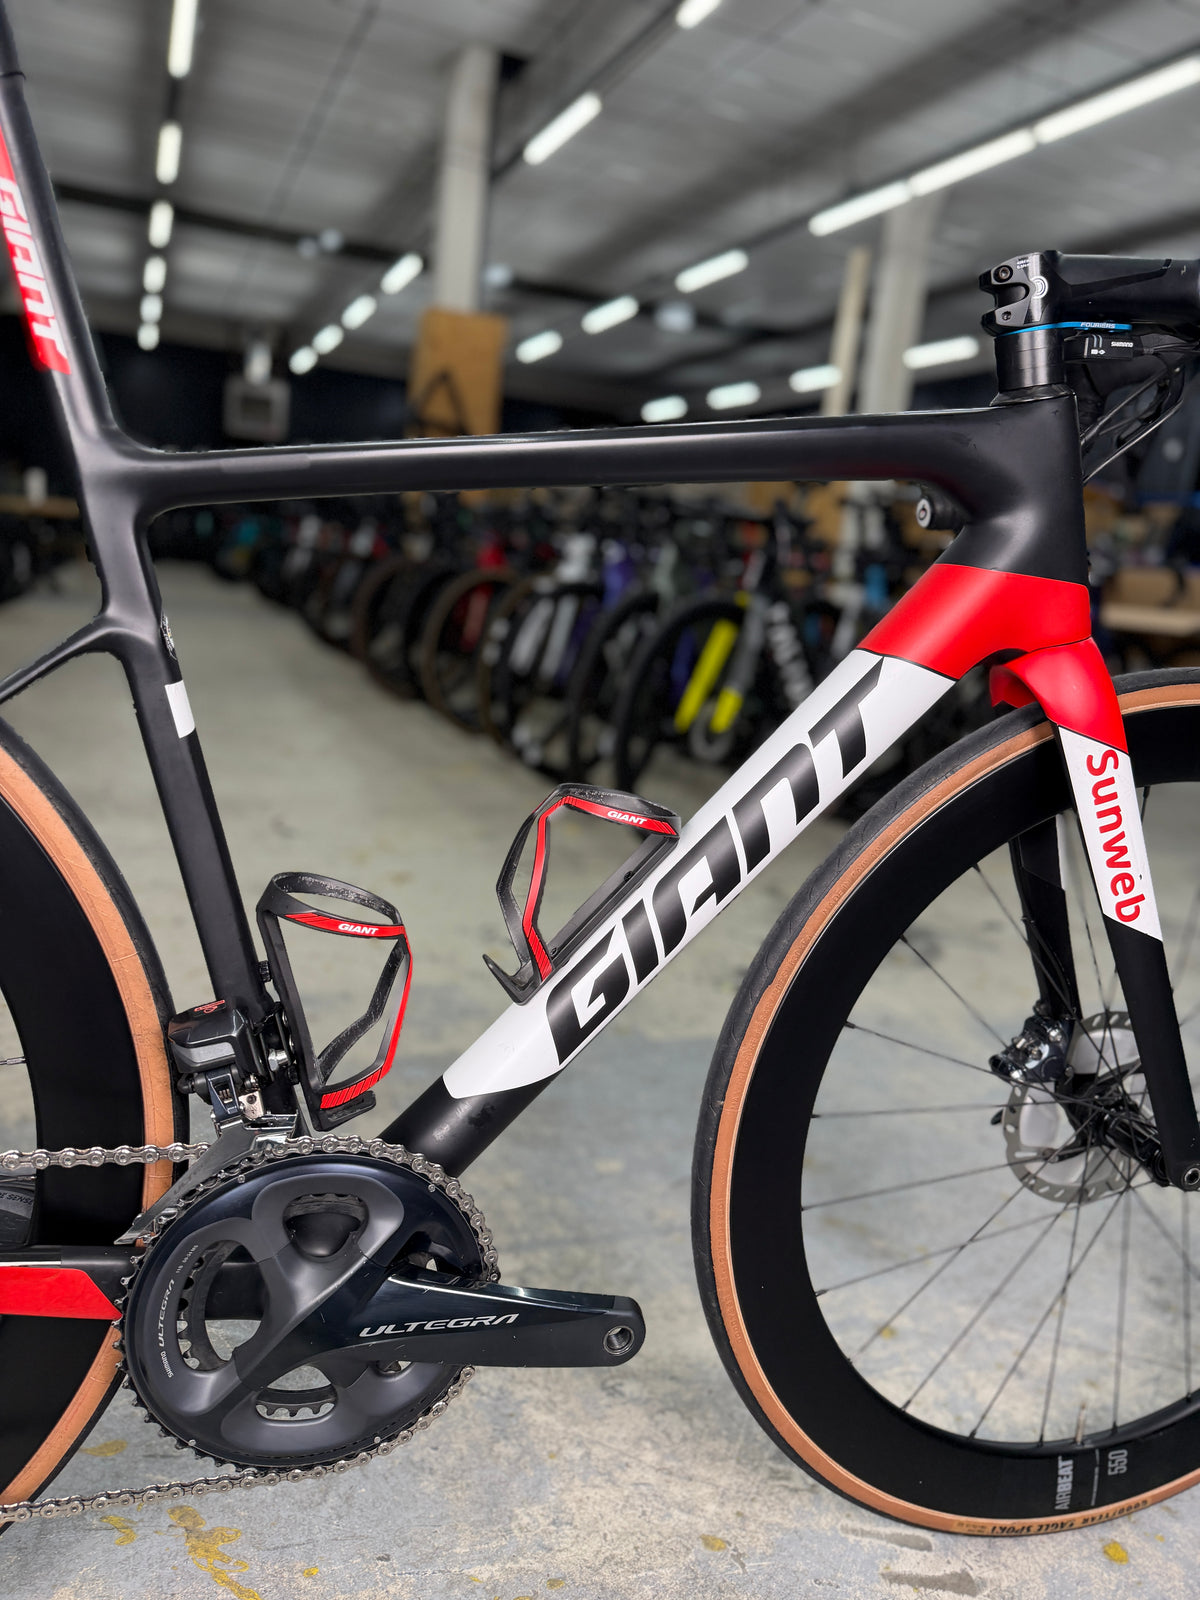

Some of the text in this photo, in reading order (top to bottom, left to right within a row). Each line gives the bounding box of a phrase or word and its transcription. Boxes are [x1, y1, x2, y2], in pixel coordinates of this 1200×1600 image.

[0, 176, 68, 360] GIANT
[607, 810, 648, 825] GIANT
[1086, 749, 1145, 923] Sunweb
[545, 656, 884, 1066] GIANT
[338, 923, 379, 935] GIANT
[158, 1278, 175, 1348] ULTEGRA
[358, 1313, 520, 1338] ULTEGRA
[1107, 1449, 1128, 1476] 550
[1054, 1455, 1074, 1511] AIRBEAT
[1082, 1499, 1149, 1525] GOODYEAR
[1036, 1518, 1077, 1534] EAGLE
